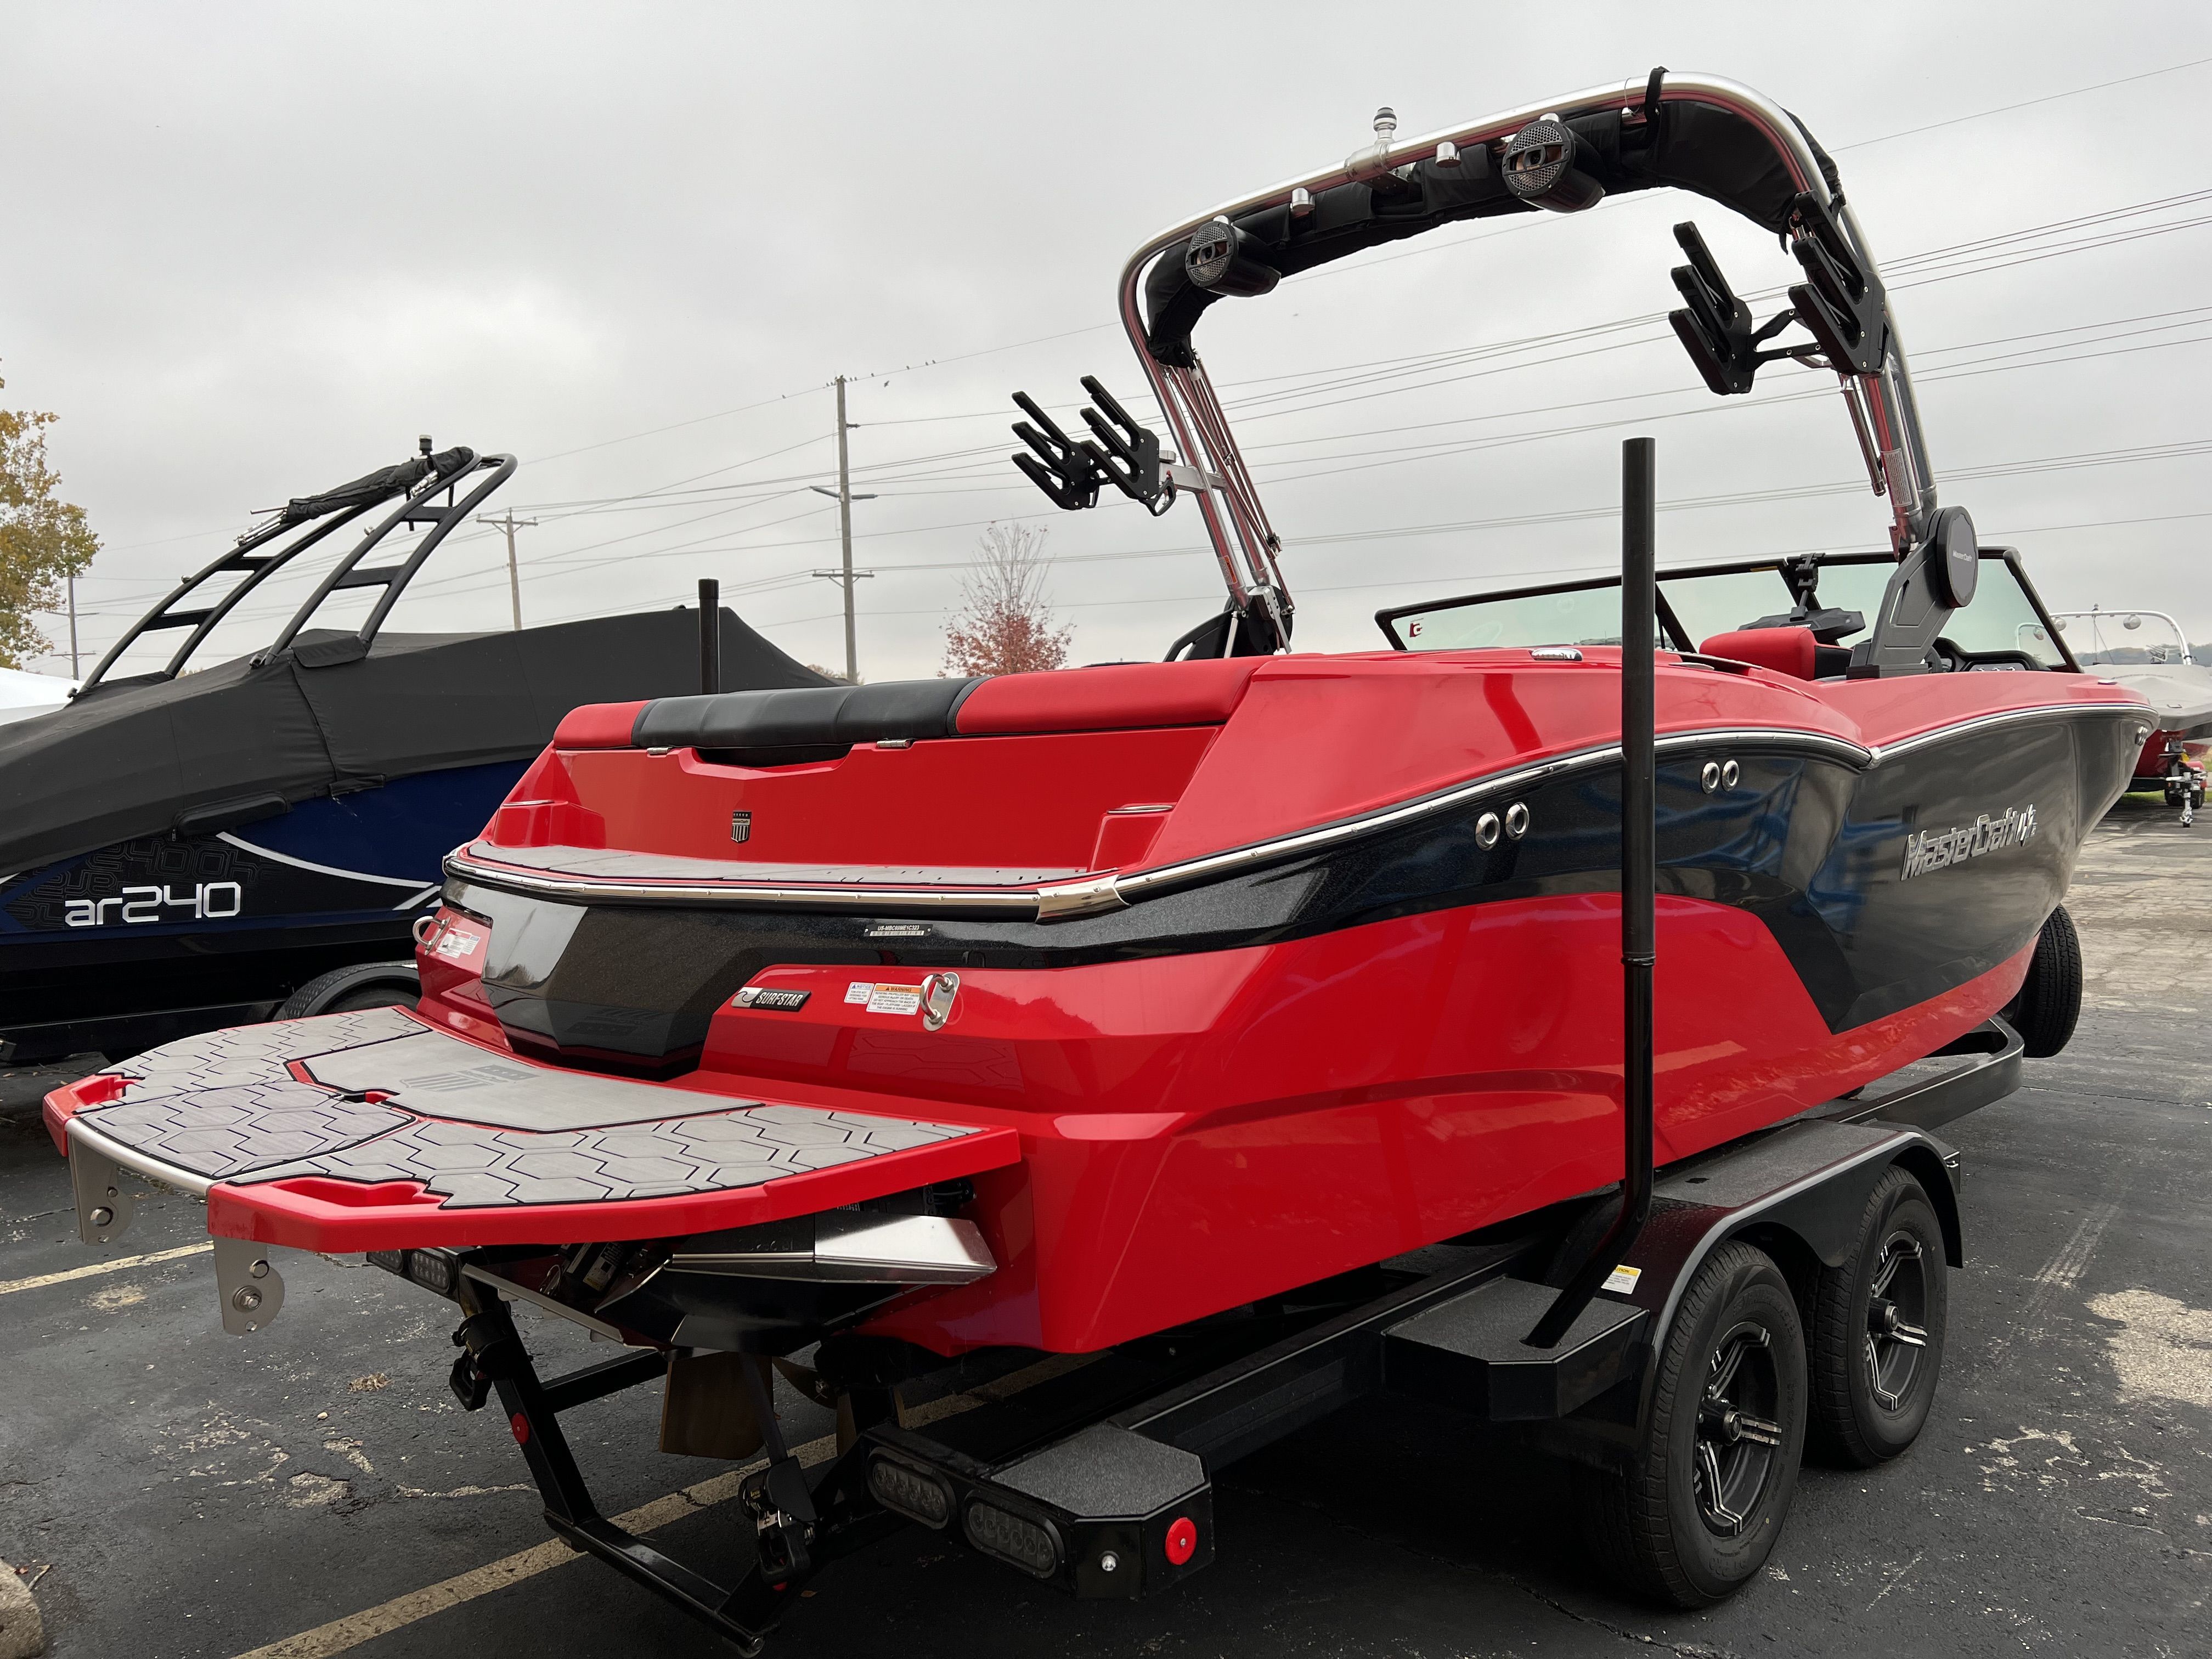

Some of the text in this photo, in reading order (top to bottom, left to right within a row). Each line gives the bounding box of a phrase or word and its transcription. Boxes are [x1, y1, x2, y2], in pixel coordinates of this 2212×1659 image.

[1901, 807, 2019, 881] MasterCraft
[64, 881, 241, 927] ar240
[755, 991, 804, 1007] SURFSTAR
